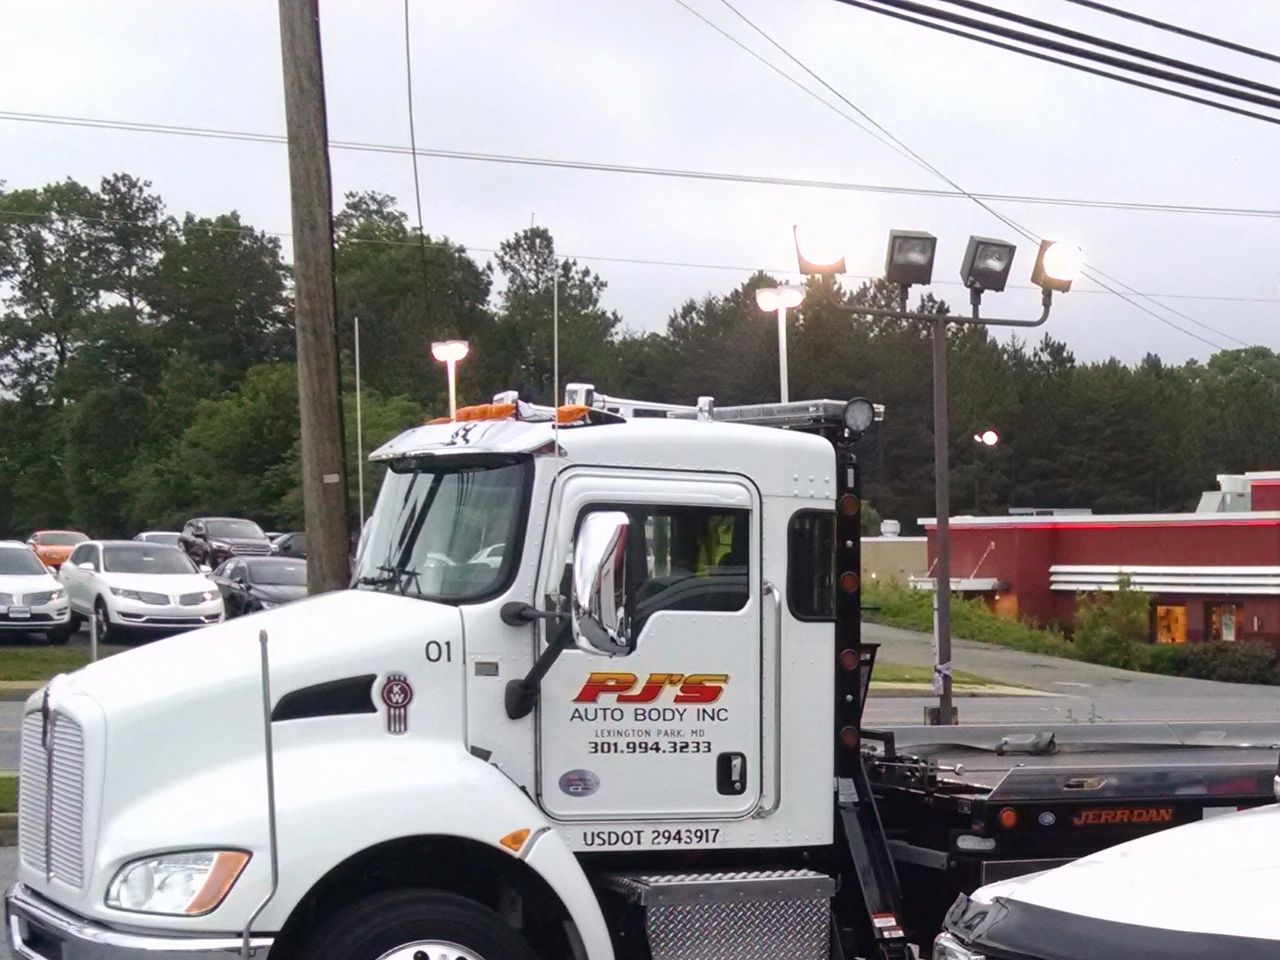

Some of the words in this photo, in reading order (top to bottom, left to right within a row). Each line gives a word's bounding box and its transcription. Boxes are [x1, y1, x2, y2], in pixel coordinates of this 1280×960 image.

[425, 640, 452, 663] 01
[572, 672, 732, 705] PJ'S
[570, 708, 625, 722] AUTO
[634, 708, 688, 722] BODY
[697, 708, 729, 722] INC
[595, 729, 651, 738] LEXINGTON
[691, 729, 705, 738] MD
[588, 741, 712, 754] 301.994.3233
[583, 831, 645, 846] USDOT
[651, 828, 720, 846] 2943917
